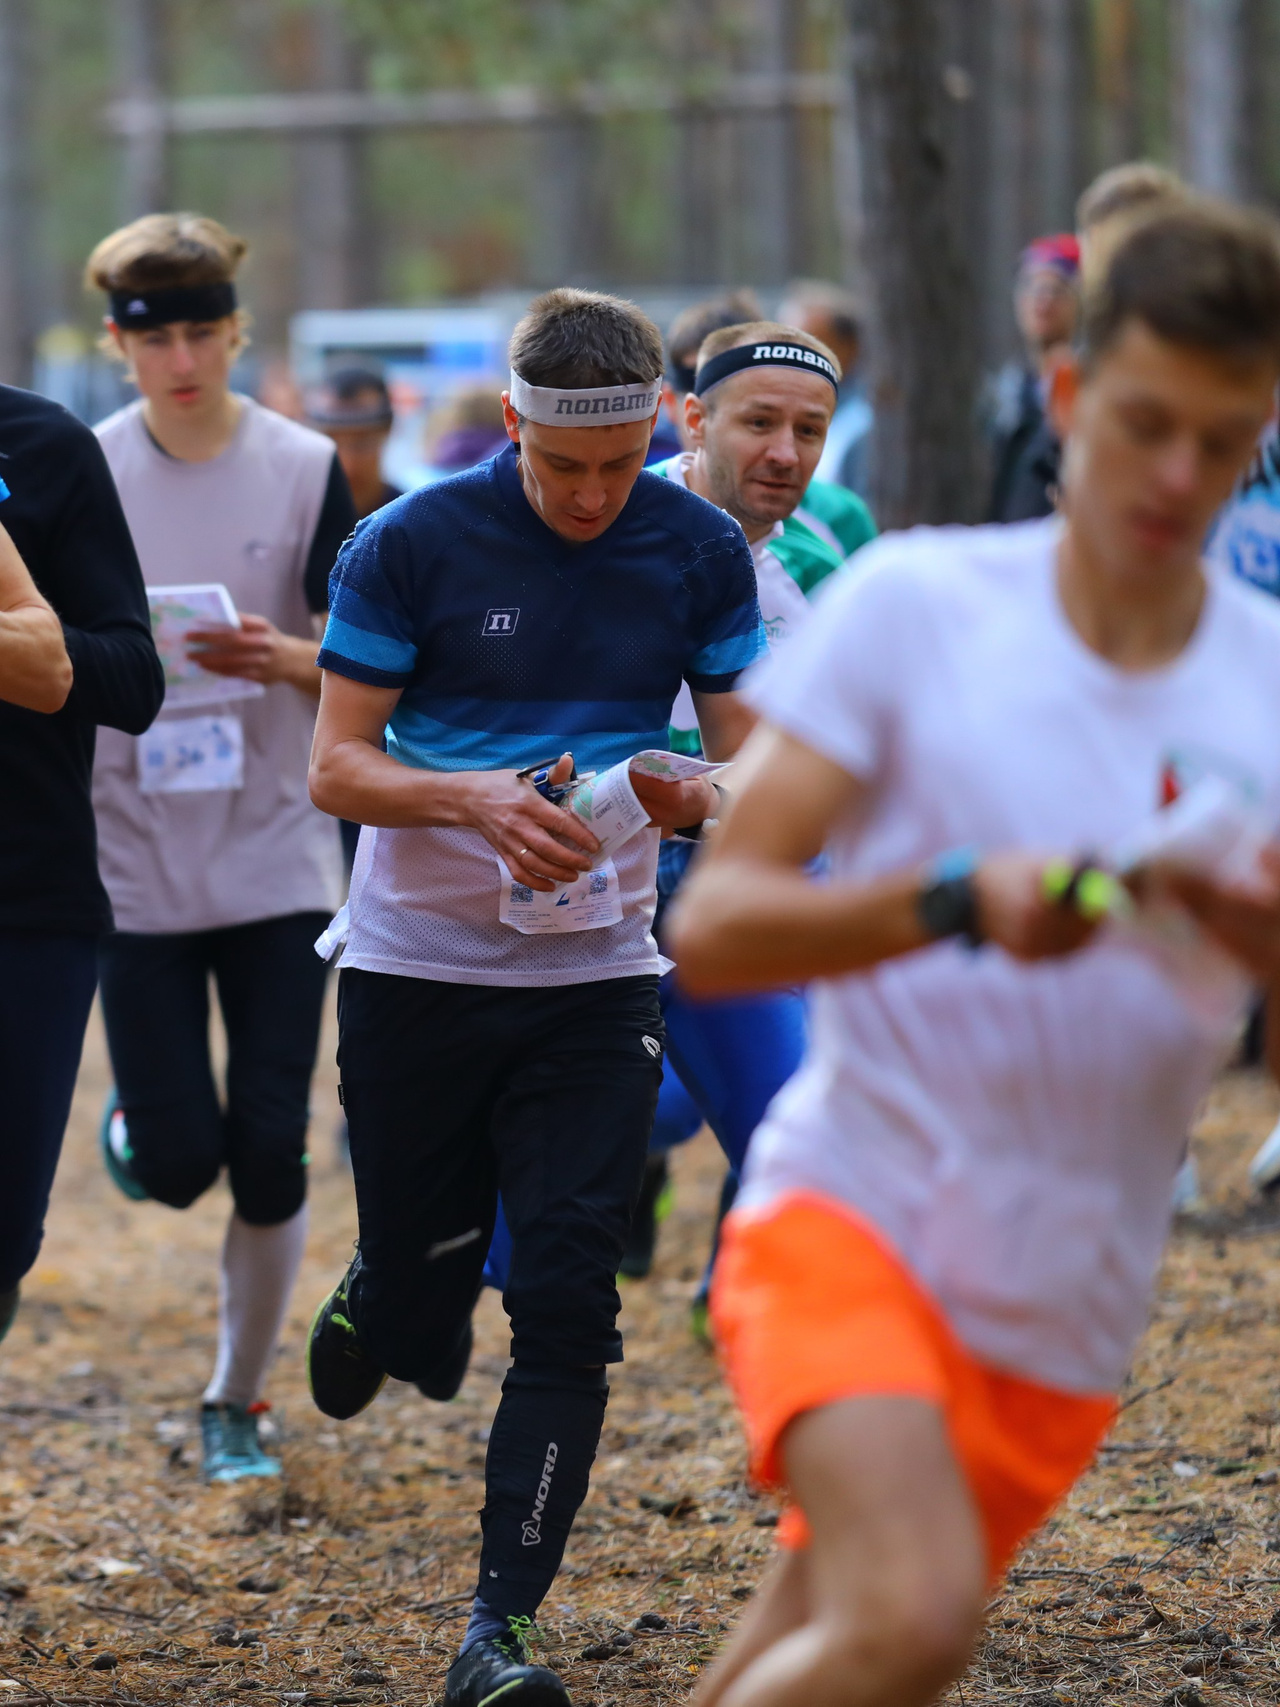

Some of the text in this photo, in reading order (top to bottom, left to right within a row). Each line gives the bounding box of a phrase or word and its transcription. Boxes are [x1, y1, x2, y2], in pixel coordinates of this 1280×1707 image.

[752, 345, 838, 380] nonam
[554, 391, 655, 415] noname
[531, 1441, 559, 1522] NORD
